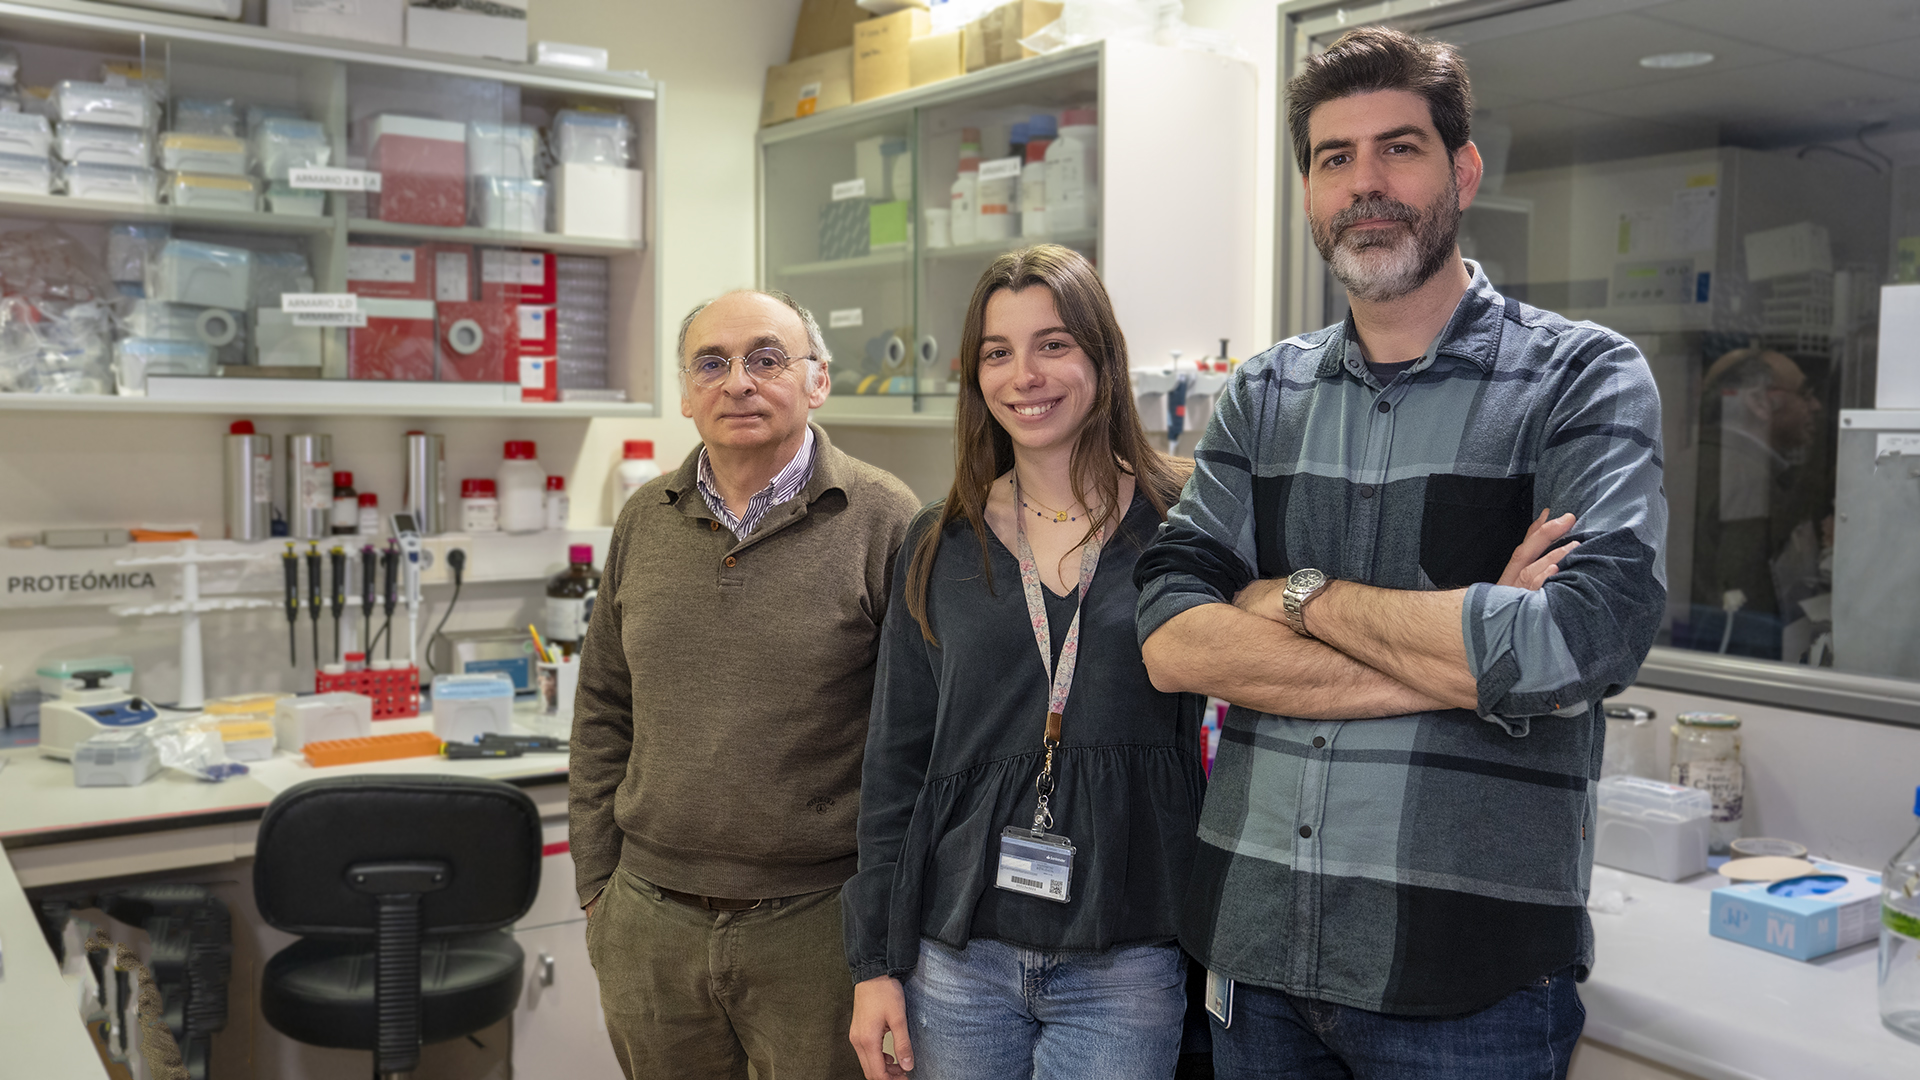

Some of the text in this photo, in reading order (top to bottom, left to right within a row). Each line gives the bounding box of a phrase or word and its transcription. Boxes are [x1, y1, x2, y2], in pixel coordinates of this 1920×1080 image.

[295, 174, 342, 185] ARMARIO
[287, 298, 335, 308] ARMARIO
[7, 569, 156, 593] PROTEÓMICA
[1766, 918, 1796, 950] M
